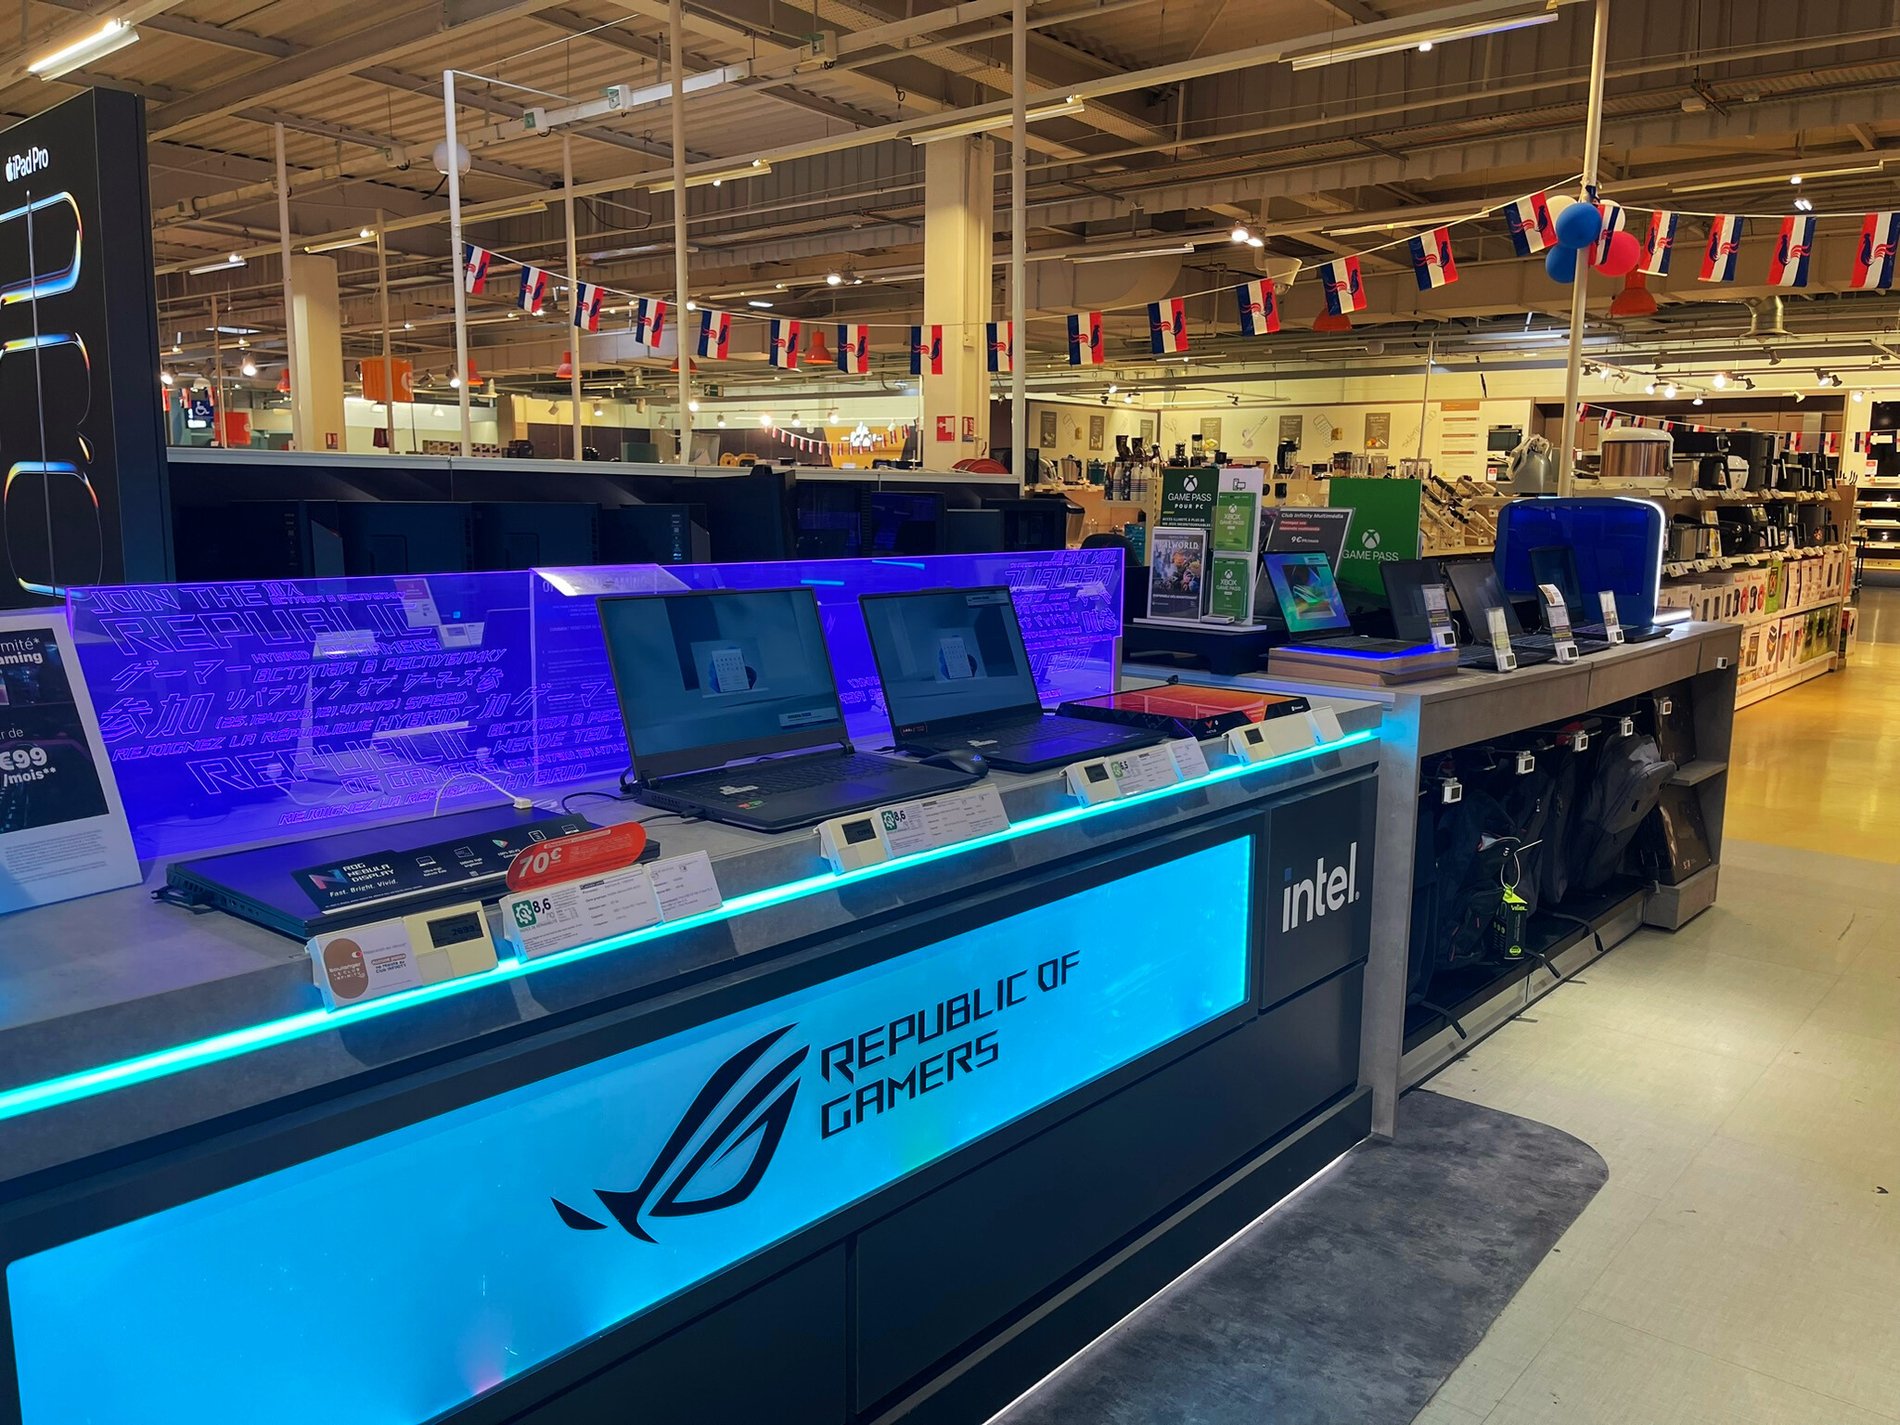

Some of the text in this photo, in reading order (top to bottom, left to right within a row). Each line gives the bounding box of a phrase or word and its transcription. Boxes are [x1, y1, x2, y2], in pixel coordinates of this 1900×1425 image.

[12, 146, 49, 180] iPad Pro
[1168, 493, 1212, 502] GAME PASS
[1342, 549, 1399, 561] GAME PASS
[1220, 578, 1237, 586] XBOX
[91, 585, 268, 614] JOIN THE
[98, 603, 432, 656] REPUBLIC
[351, 637, 444, 657] GAMERS
[111, 659, 252, 692] ゲーマー
[404, 691, 469, 710] SPEED
[98, 692, 215, 744] 参加
[8, 727, 24, 739] de
[112, 736, 226, 762] REJOIGNEZ
[229, 732, 257, 747] LA
[375, 707, 461, 732] HYBRID
[493, 731, 568, 755] WERDE
[186, 725, 491, 794] REPUBLIC
[341, 757, 501, 796] OF GAMERS
[502, 762, 587, 791] HYBRID
[343, 862, 367, 872] ROG
[346, 863, 391, 878] NEBULA
[351, 869, 395, 883] DISPLAY
[519, 847, 562, 879] 70€
[329, 890, 348, 898] Fast.
[350, 884, 375, 893] Bright.
[376, 878, 399, 888] Vivid.
[532, 898, 551, 914] 8,6
[821, 950, 1081, 1085] REPUBLIC OF
[821, 1029, 999, 1141] GAMERS
